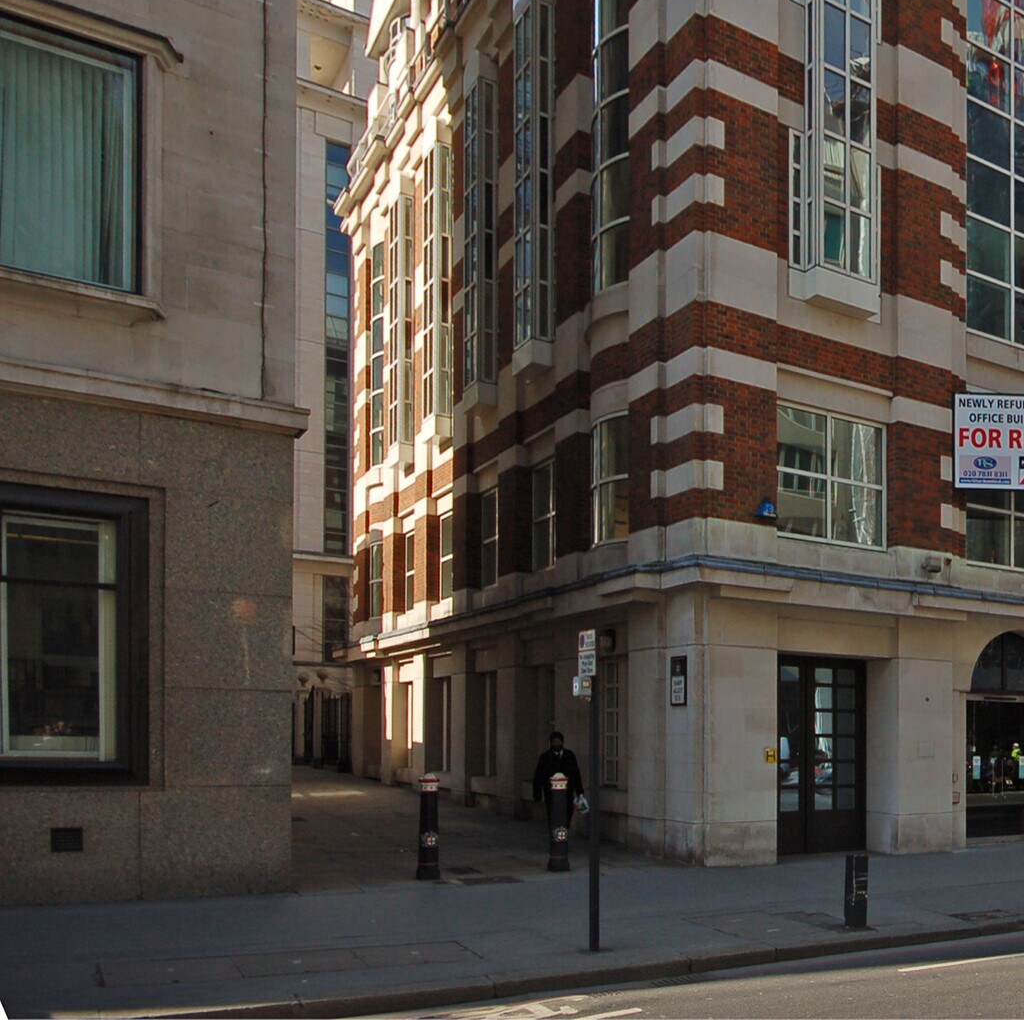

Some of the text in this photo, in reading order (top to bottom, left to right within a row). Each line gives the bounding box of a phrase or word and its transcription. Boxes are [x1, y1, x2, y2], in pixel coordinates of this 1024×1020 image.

[959, 398, 994, 409] NEWLY
[969, 413, 1004, 423] OFFICE
[959, 427, 1002, 449] FOR
[766, 749, 776, 763] H
